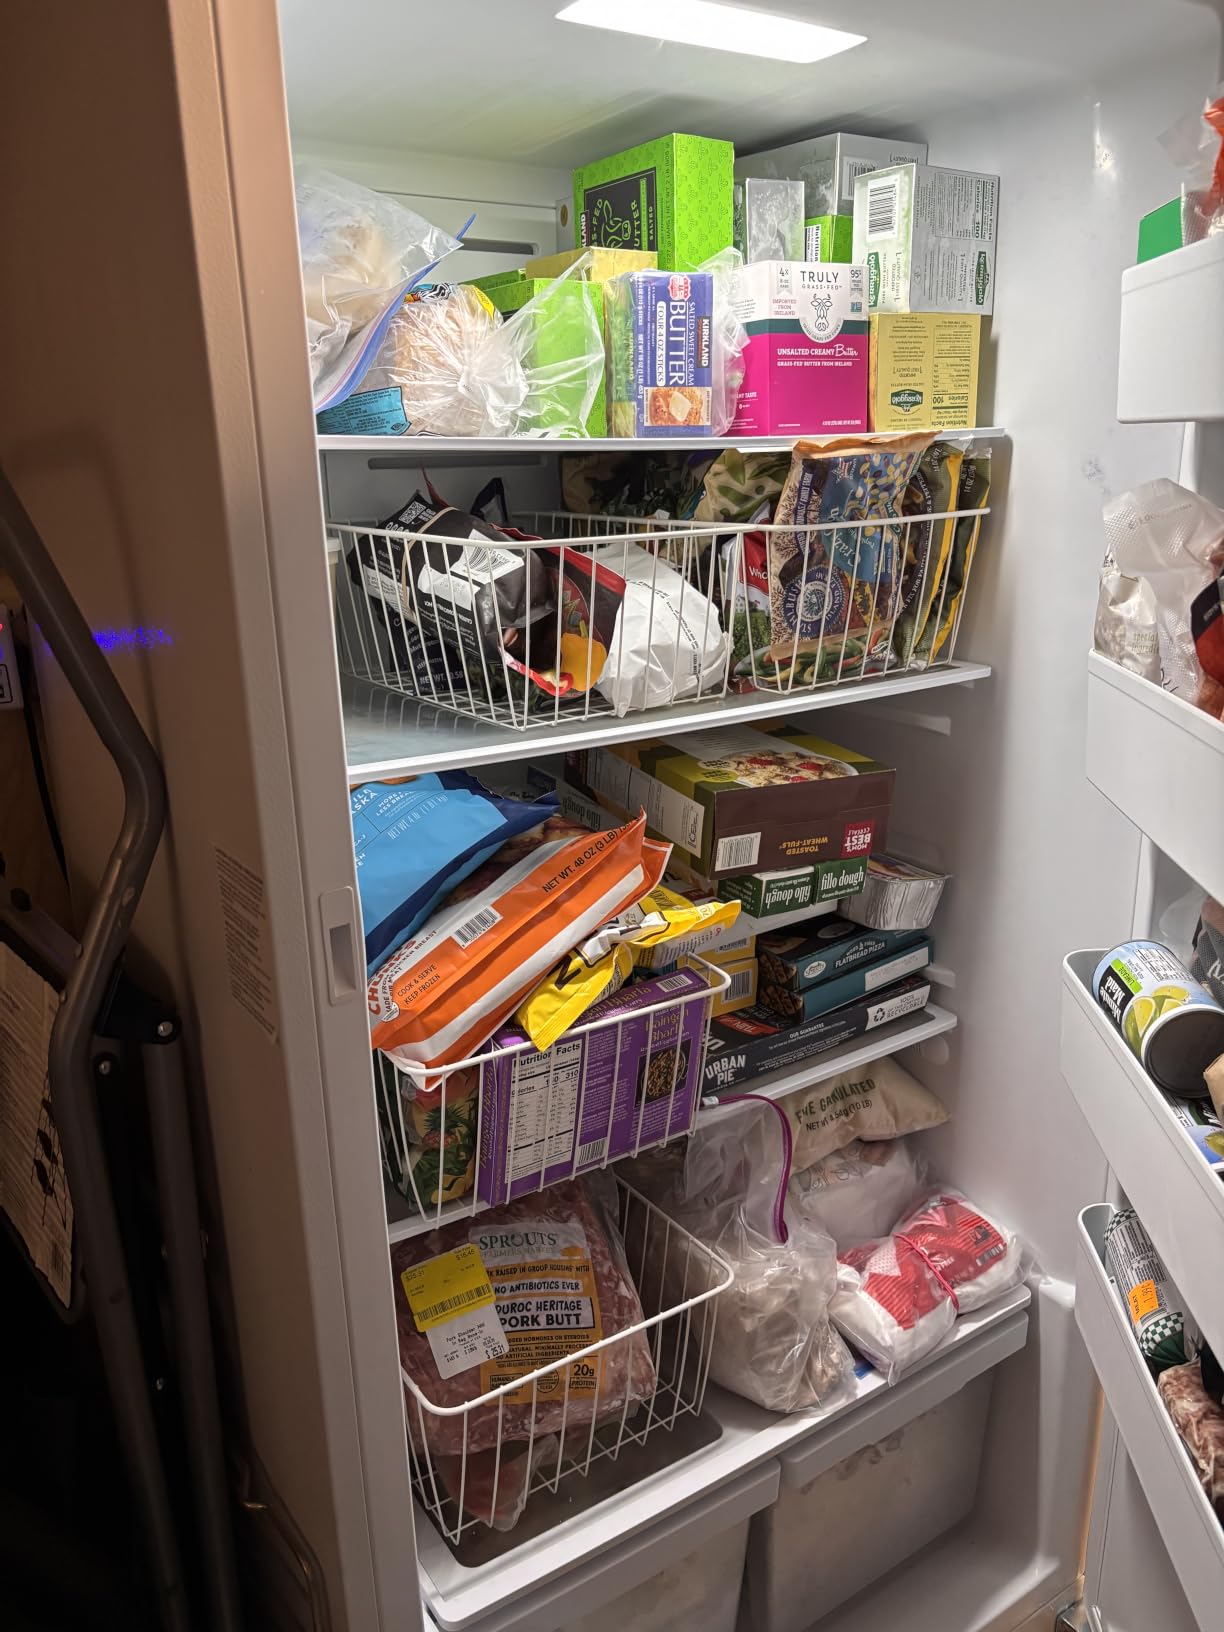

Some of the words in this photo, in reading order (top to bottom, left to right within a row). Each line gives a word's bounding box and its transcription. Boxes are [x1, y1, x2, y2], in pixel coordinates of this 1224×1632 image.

[800, 270, 839, 283] TRULY
[977, 253, 986, 304] Kerrygold
[657, 340, 664, 352] OZ
[669, 301, 686, 386] BUTTER
[701, 318, 710, 367] KIRKLAND
[777, 348, 809, 356] UNSALTED
[811, 348, 834, 356] CREAMY
[834, 344, 858, 357] Butter
[892, 394, 922, 404] Kerrygold
[932, 396, 944, 404] 100
[376, 804, 390, 817] LESS
[844, 833, 873, 847] BEST
[786, 844, 820, 856] TOASTED
[542, 878, 559, 893] NET
[559, 866, 576, 880] WT.
[574, 857, 585, 868] 48
[584, 847, 597, 860] OZ
[595, 841, 605, 852] (3
[821, 872, 838, 891] fillo
[838, 865, 864, 886] dough
[765, 888, 793, 909] dough
[794, 884, 811, 903] fillo
[414, 930, 438, 950] BREAST
[835, 949, 868, 968] FLATBREAD
[868, 941, 885, 954] PIZZA
[397, 982, 414, 997] COOK
[418, 964, 437, 980] SERVE
[1118, 966, 1135, 986] LIMEADE
[403, 990, 420, 1005] KEEP
[419, 974, 441, 993] FROZEN
[1104, 975, 1126, 1006] Maid
[887, 999, 924, 1019] RECYCLABLE
[1099, 985, 1122, 1025] Minute
[789, 1031, 799, 1039] OUR
[799, 1022, 825, 1036] GUARANTEE
[556, 1043, 581, 1056] Facts
[565, 1069, 579, 1079] 310
[705, 1054, 746, 1080] URBAN
[717, 1069, 735, 1085] PIE
[806, 1121, 820, 1132] NET
[848, 1102, 861, 1114] (10
[480, 1231, 557, 1251] SPROUTS
[495, 1267, 518, 1277] RAISED
[528, 1264, 548, 1273] GROUP
[549, 1264, 573, 1272] HOUSING
[576, 1264, 589, 1272] WITH
[494, 1285, 507, 1294] NO
[509, 1281, 560, 1293] ANTIBIOTICS
[562, 1281, 580, 1290] EVER
[496, 1301, 532, 1315] DUROC
[536, 1300, 582, 1312] HERITAGE
[500, 1313, 541, 1328] PORK
[545, 1312, 582, 1326] BUTT
[573, 1364, 595, 1376] 20g
